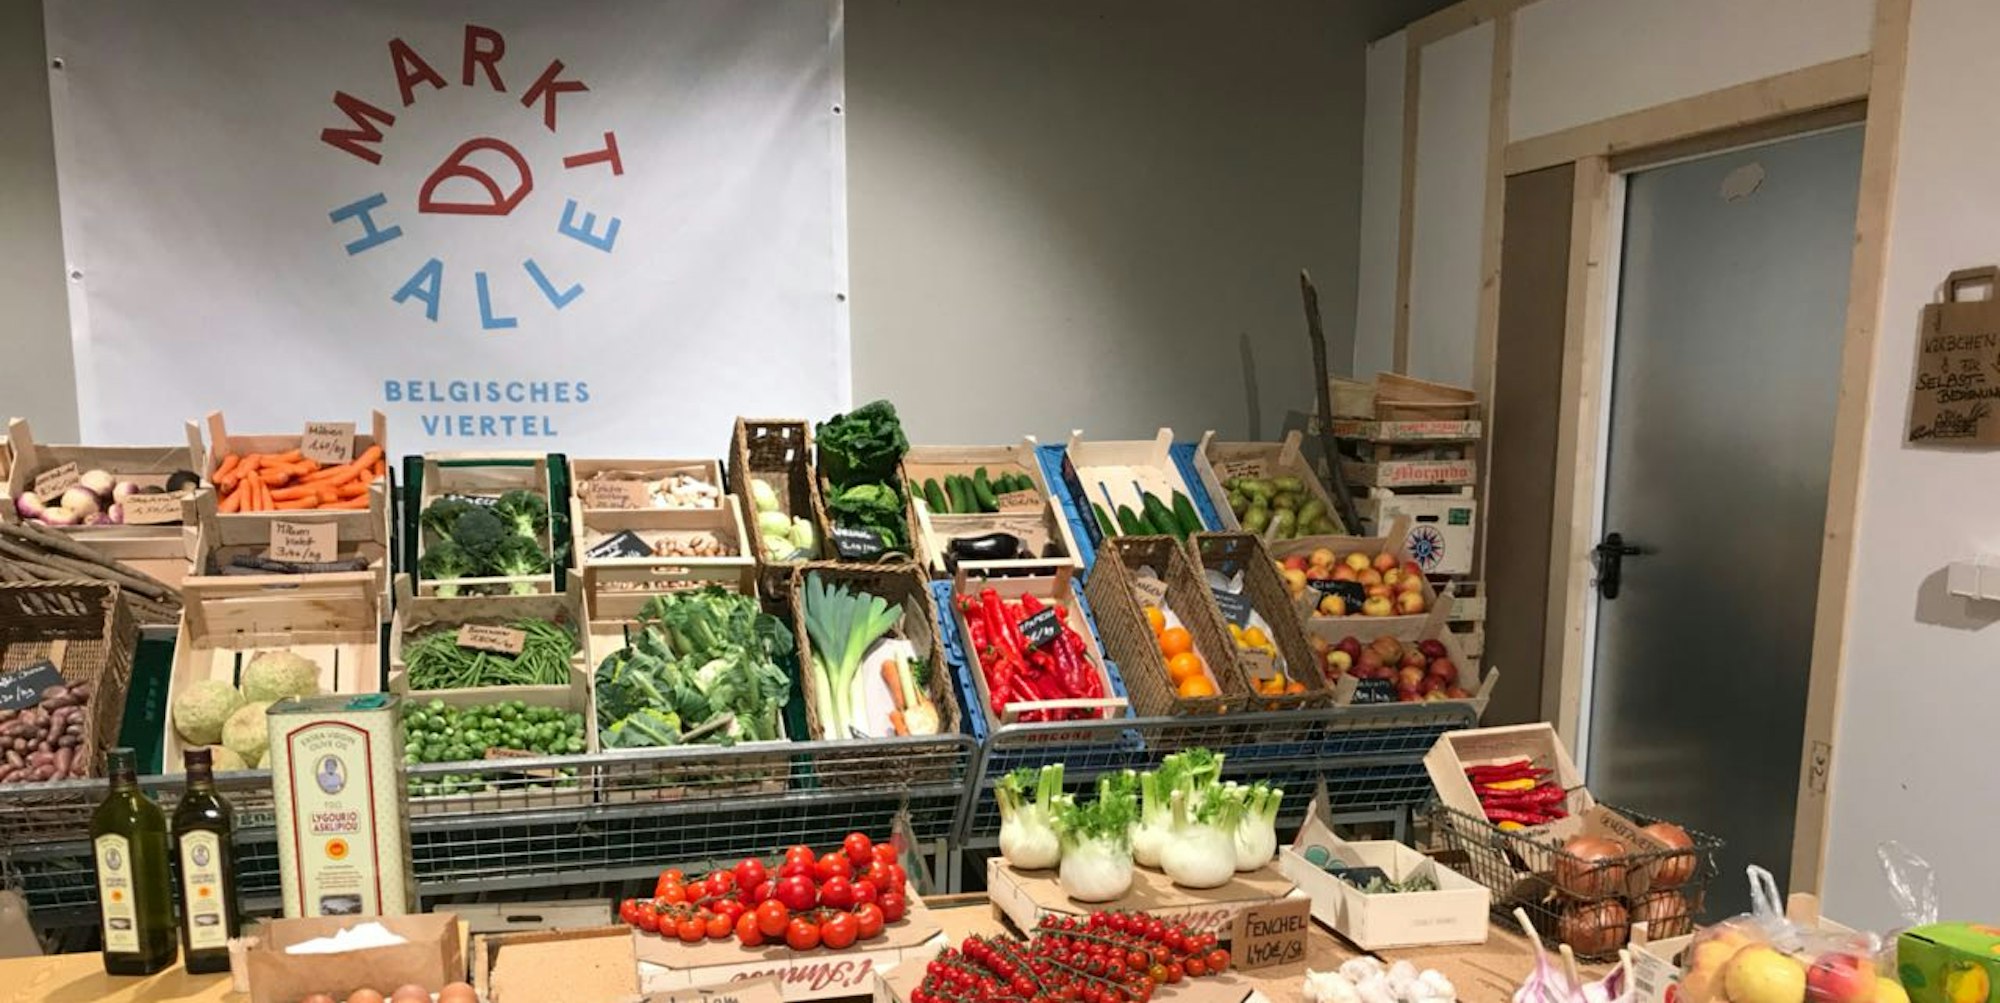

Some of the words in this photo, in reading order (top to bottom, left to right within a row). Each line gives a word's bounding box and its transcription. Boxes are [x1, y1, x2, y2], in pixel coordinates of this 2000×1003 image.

[320, 23, 624, 166] MARKT
[328, 192, 622, 330] HALLE
[384, 380, 590, 403] BELGISCHES
[421, 414, 558, 437] VIERTEL
[1245, 913, 1306, 938] FENCHEL
